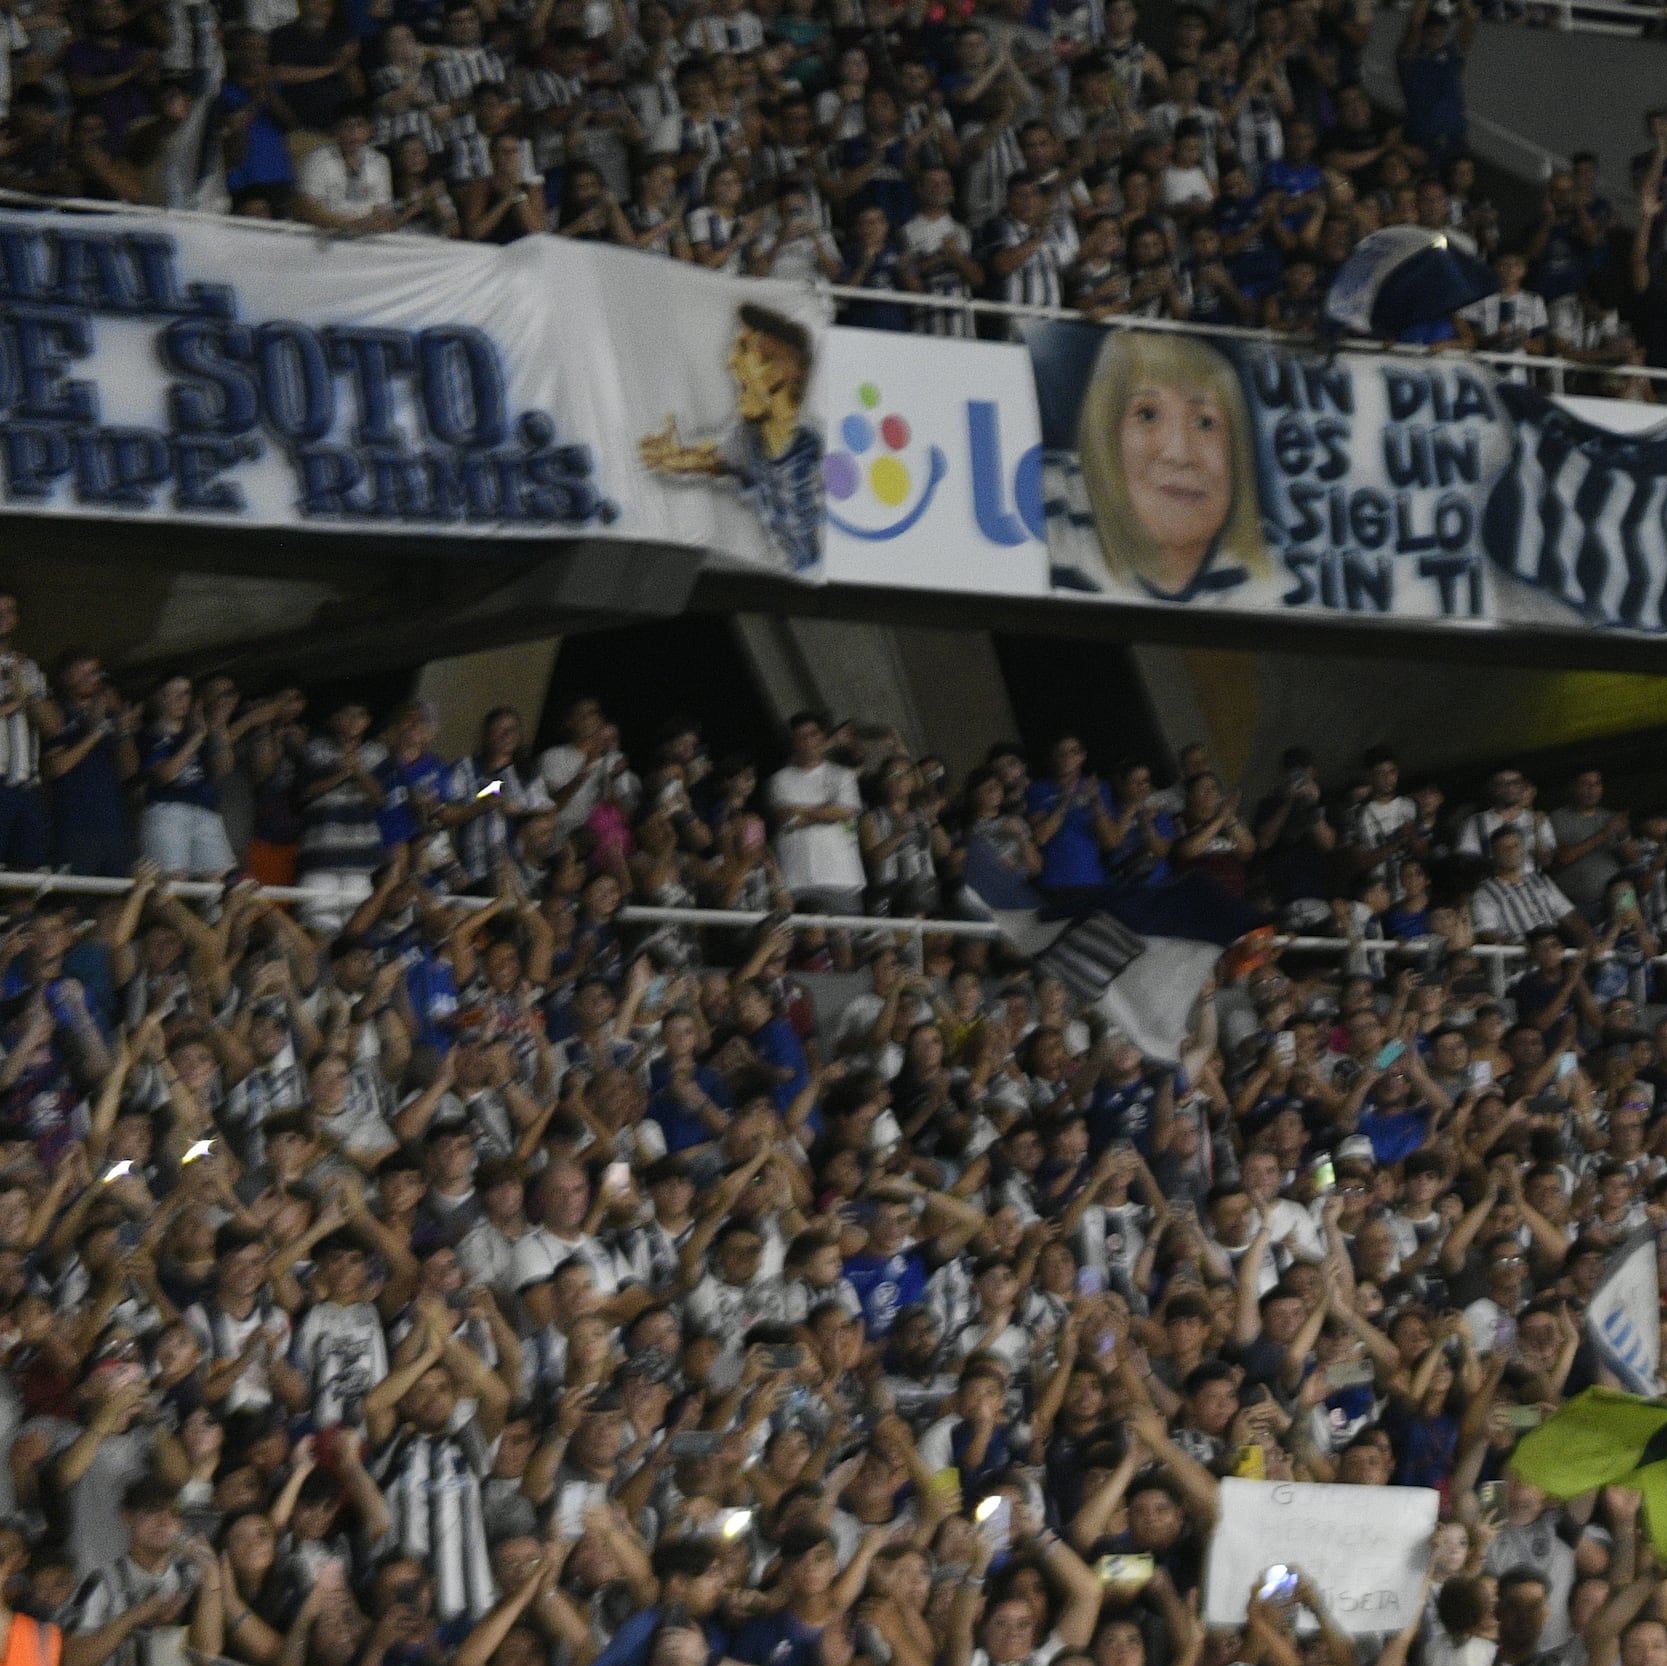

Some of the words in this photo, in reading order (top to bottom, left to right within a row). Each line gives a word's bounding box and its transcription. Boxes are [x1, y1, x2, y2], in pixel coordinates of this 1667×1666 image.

[1382, 363, 1496, 422] DIA
[1385, 420, 1480, 488] UN
[1287, 482, 1475, 552] SIGLO
[1282, 549, 1394, 613] SIN
[1418, 553, 1485, 615] TI
